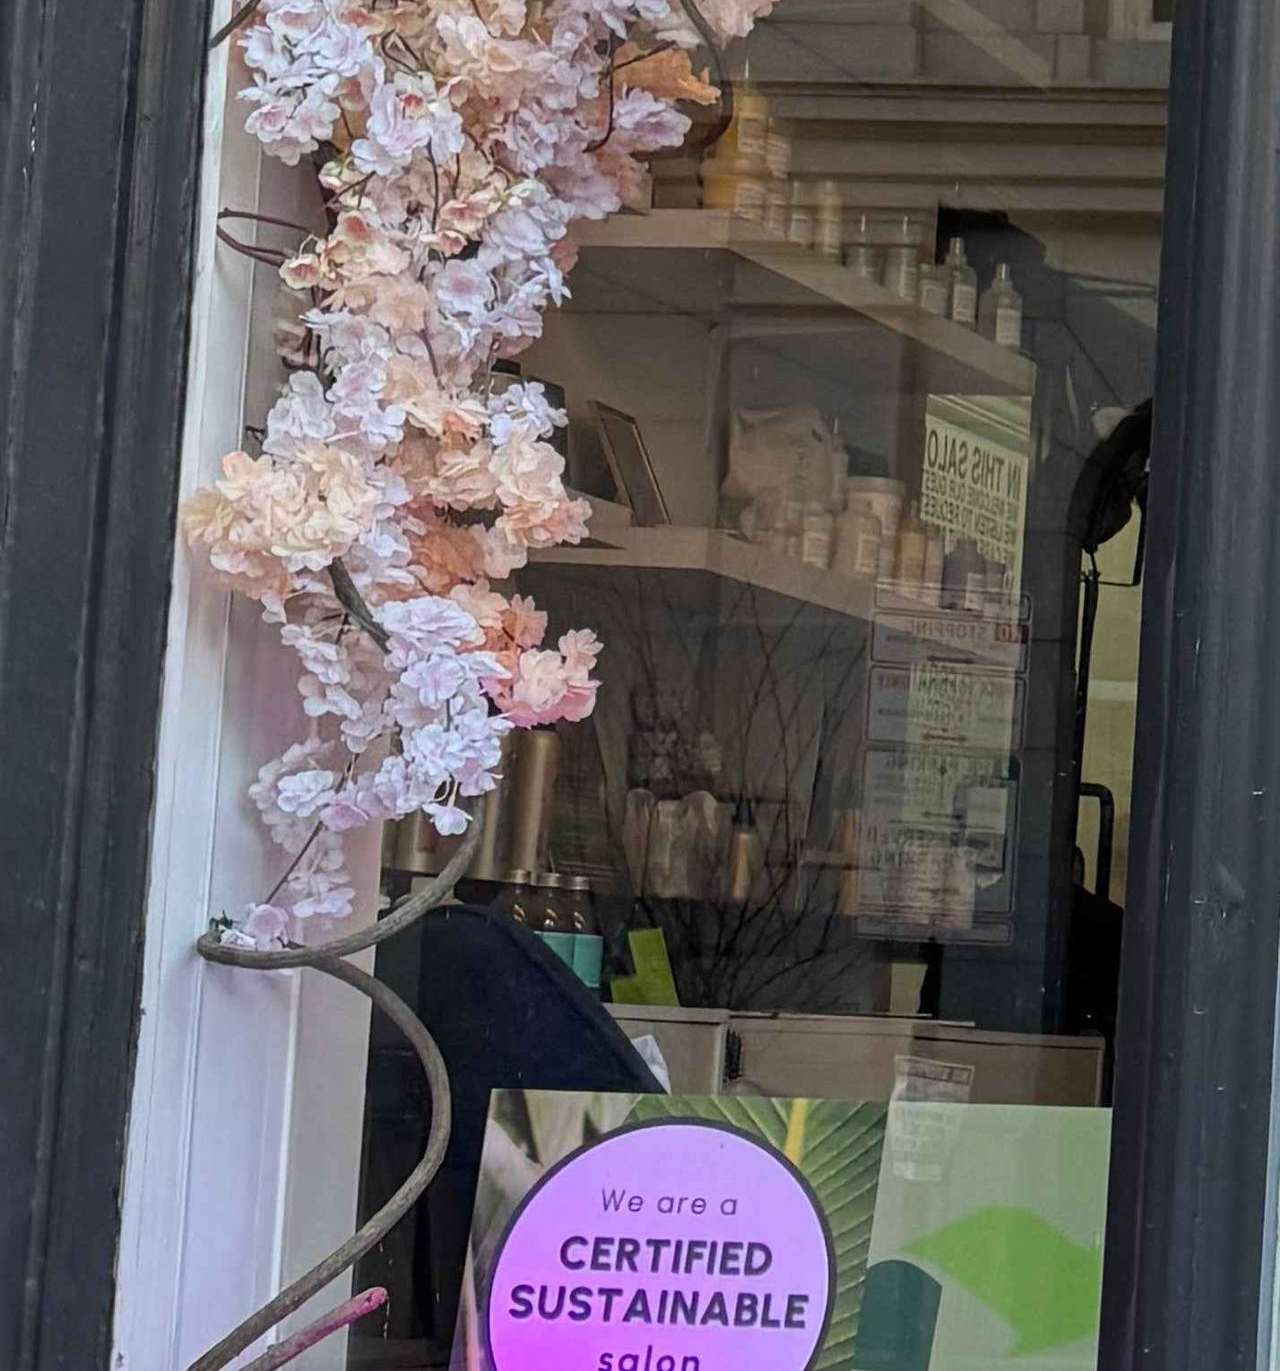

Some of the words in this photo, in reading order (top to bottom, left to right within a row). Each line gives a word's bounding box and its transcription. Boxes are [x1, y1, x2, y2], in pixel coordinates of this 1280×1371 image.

[601, 1188, 644, 1212] We
[656, 1195, 707, 1215] are
[719, 1197, 738, 1216] a
[559, 1235, 773, 1277] CERTIFIED
[508, 1283, 810, 1329] SUSTAINABLE
[598, 1344, 701, 1371] salon
